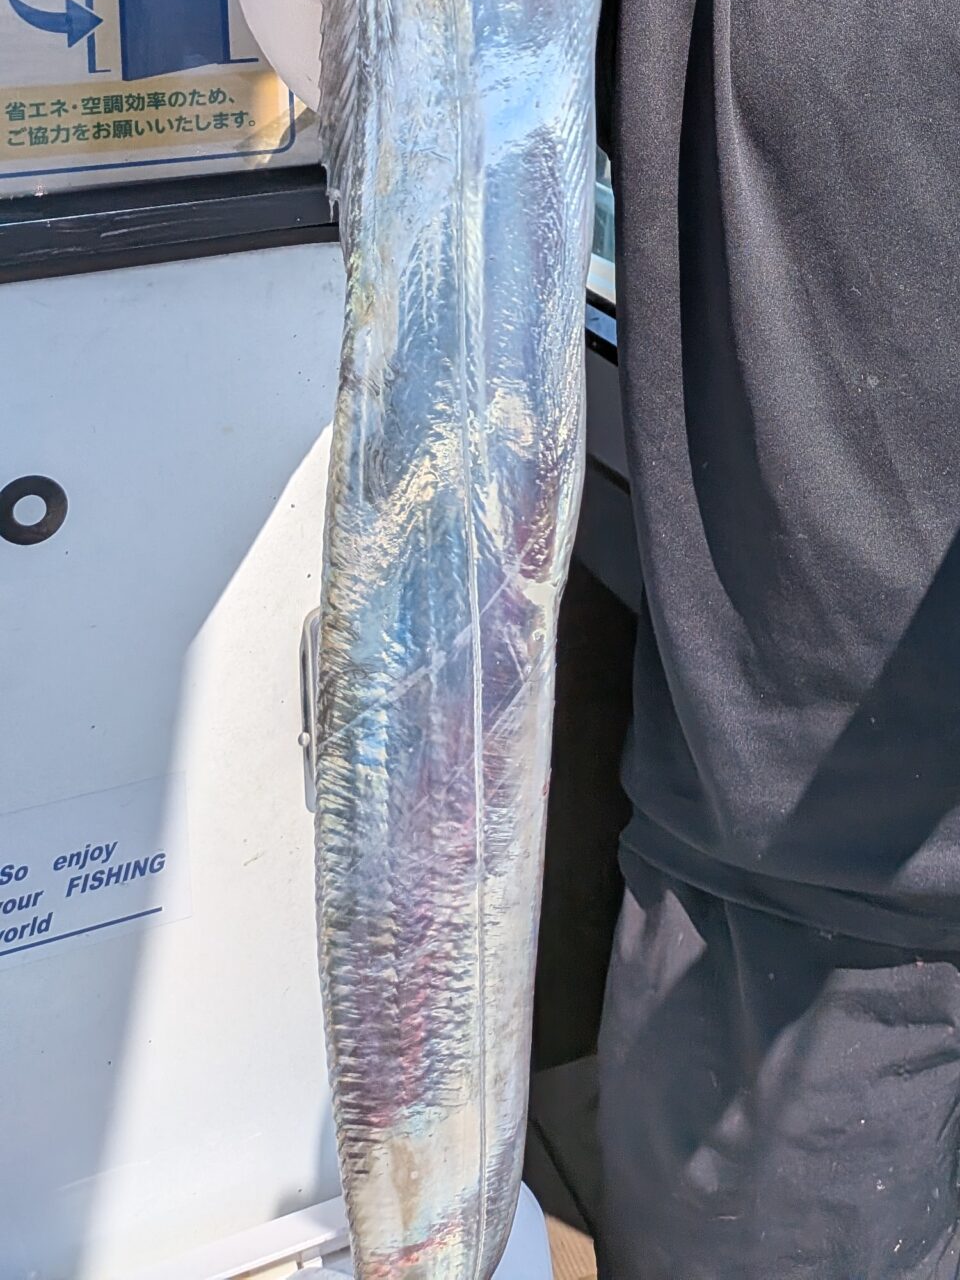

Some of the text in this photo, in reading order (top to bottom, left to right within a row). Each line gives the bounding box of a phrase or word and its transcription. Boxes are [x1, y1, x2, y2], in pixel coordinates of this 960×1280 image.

[5, 87, 237, 122] 省エネ・空調効率のため、
[7, 111, 257, 147] ご協力をお願いいたします。
[0, 841, 119, 886] So enjoy
[0, 853, 166, 914] our FISHING
[0, 912, 53, 943] orld
